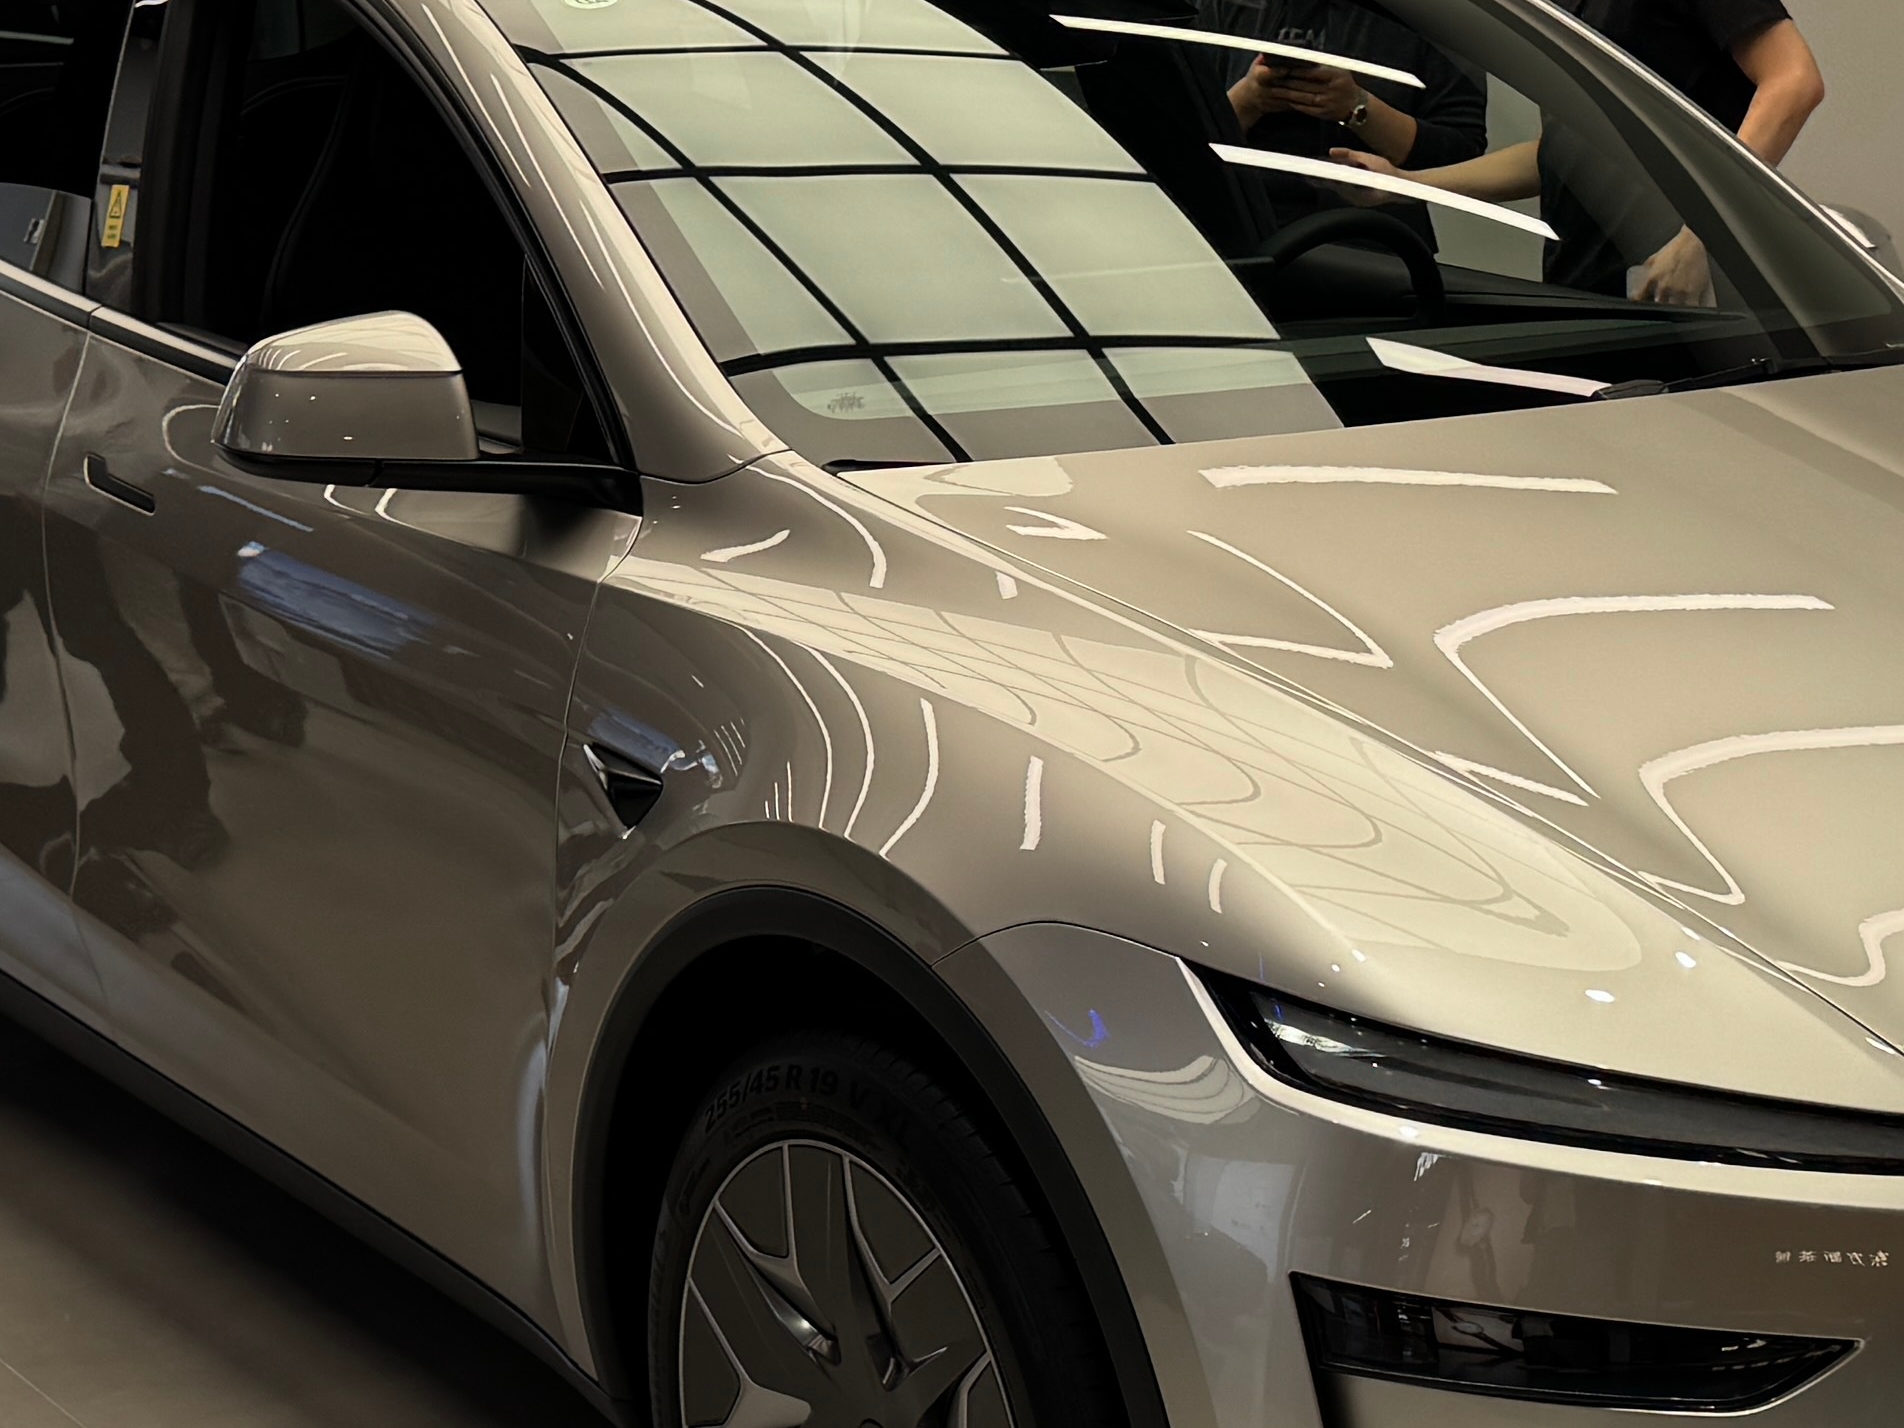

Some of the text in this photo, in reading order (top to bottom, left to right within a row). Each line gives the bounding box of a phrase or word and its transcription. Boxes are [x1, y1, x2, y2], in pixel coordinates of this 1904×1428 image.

[704, 1065, 782, 1132] 255/45
[784, 1063, 804, 1091] R
[809, 1066, 839, 1097] 19
